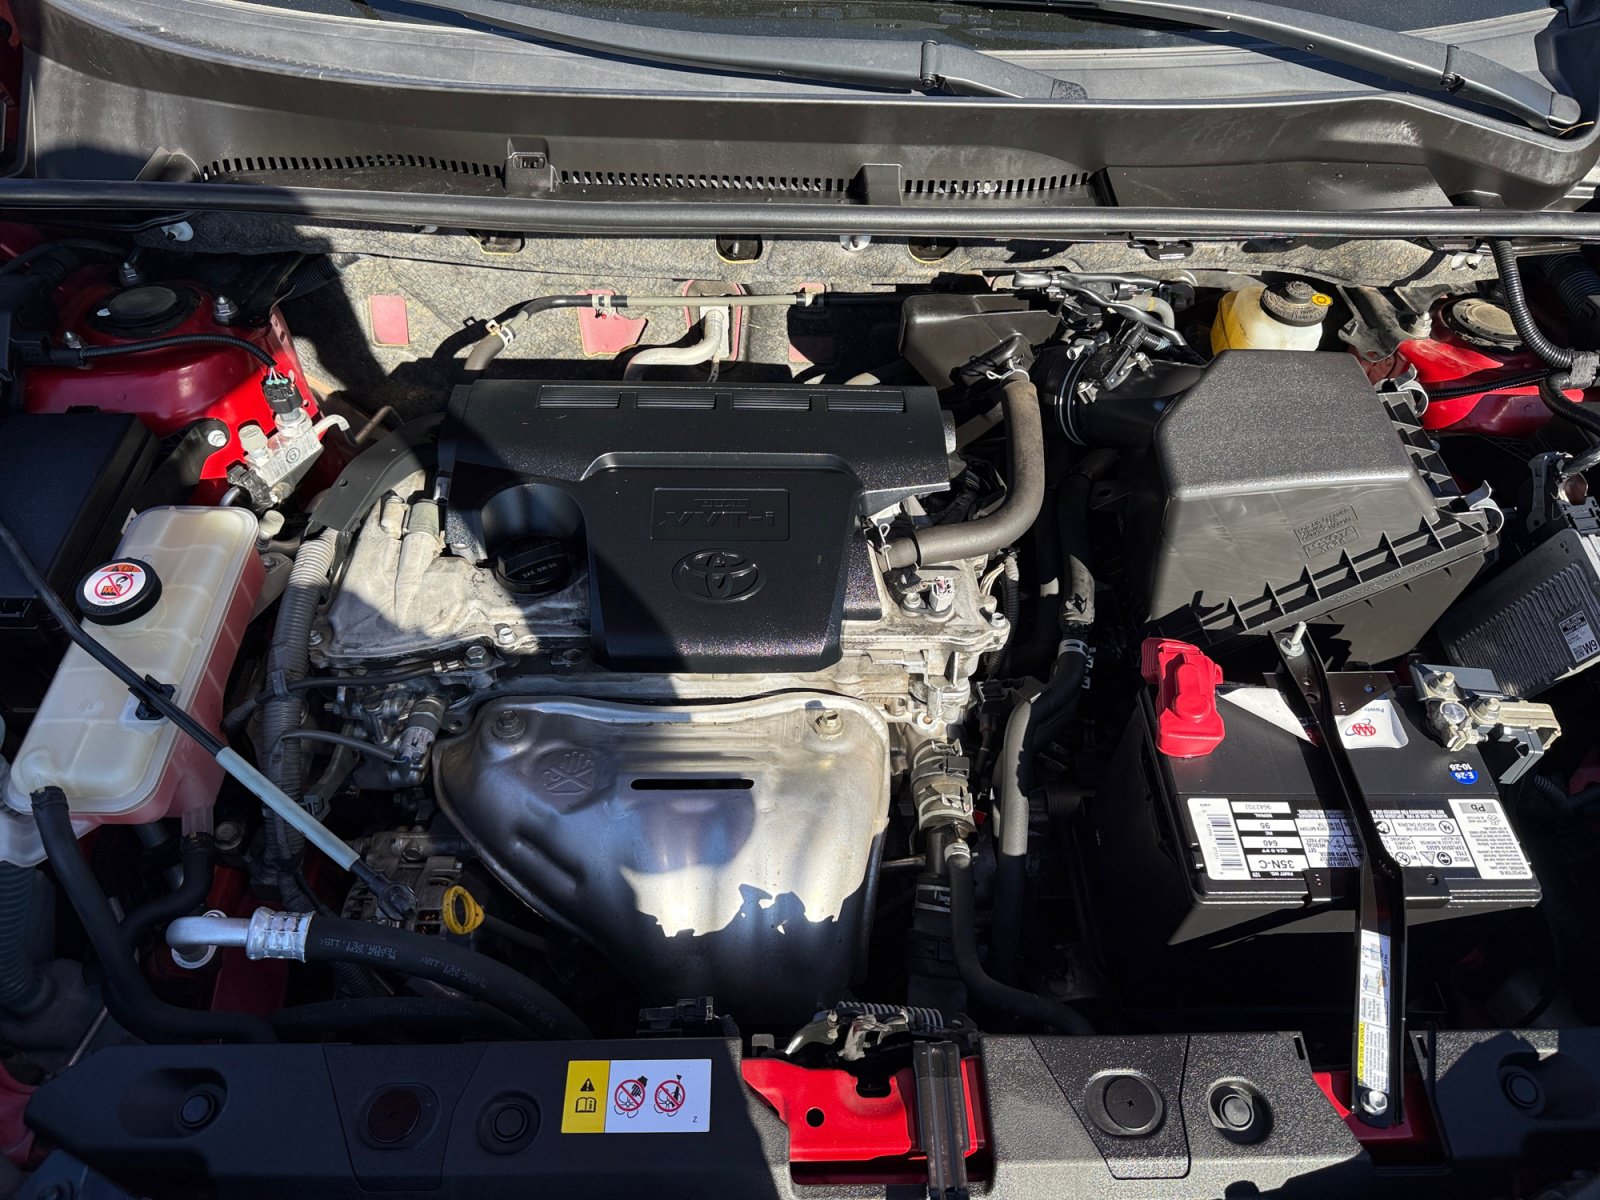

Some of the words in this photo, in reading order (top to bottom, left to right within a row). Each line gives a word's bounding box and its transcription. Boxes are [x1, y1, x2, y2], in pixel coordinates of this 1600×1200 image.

[1582, 639, 1598, 654] W9
[1449, 762, 1473, 771] 10-26
[1455, 771, 1475, 779] E-26
[1470, 804, 1486, 812] Pb
[1258, 860, 1295, 869] 35N-C
